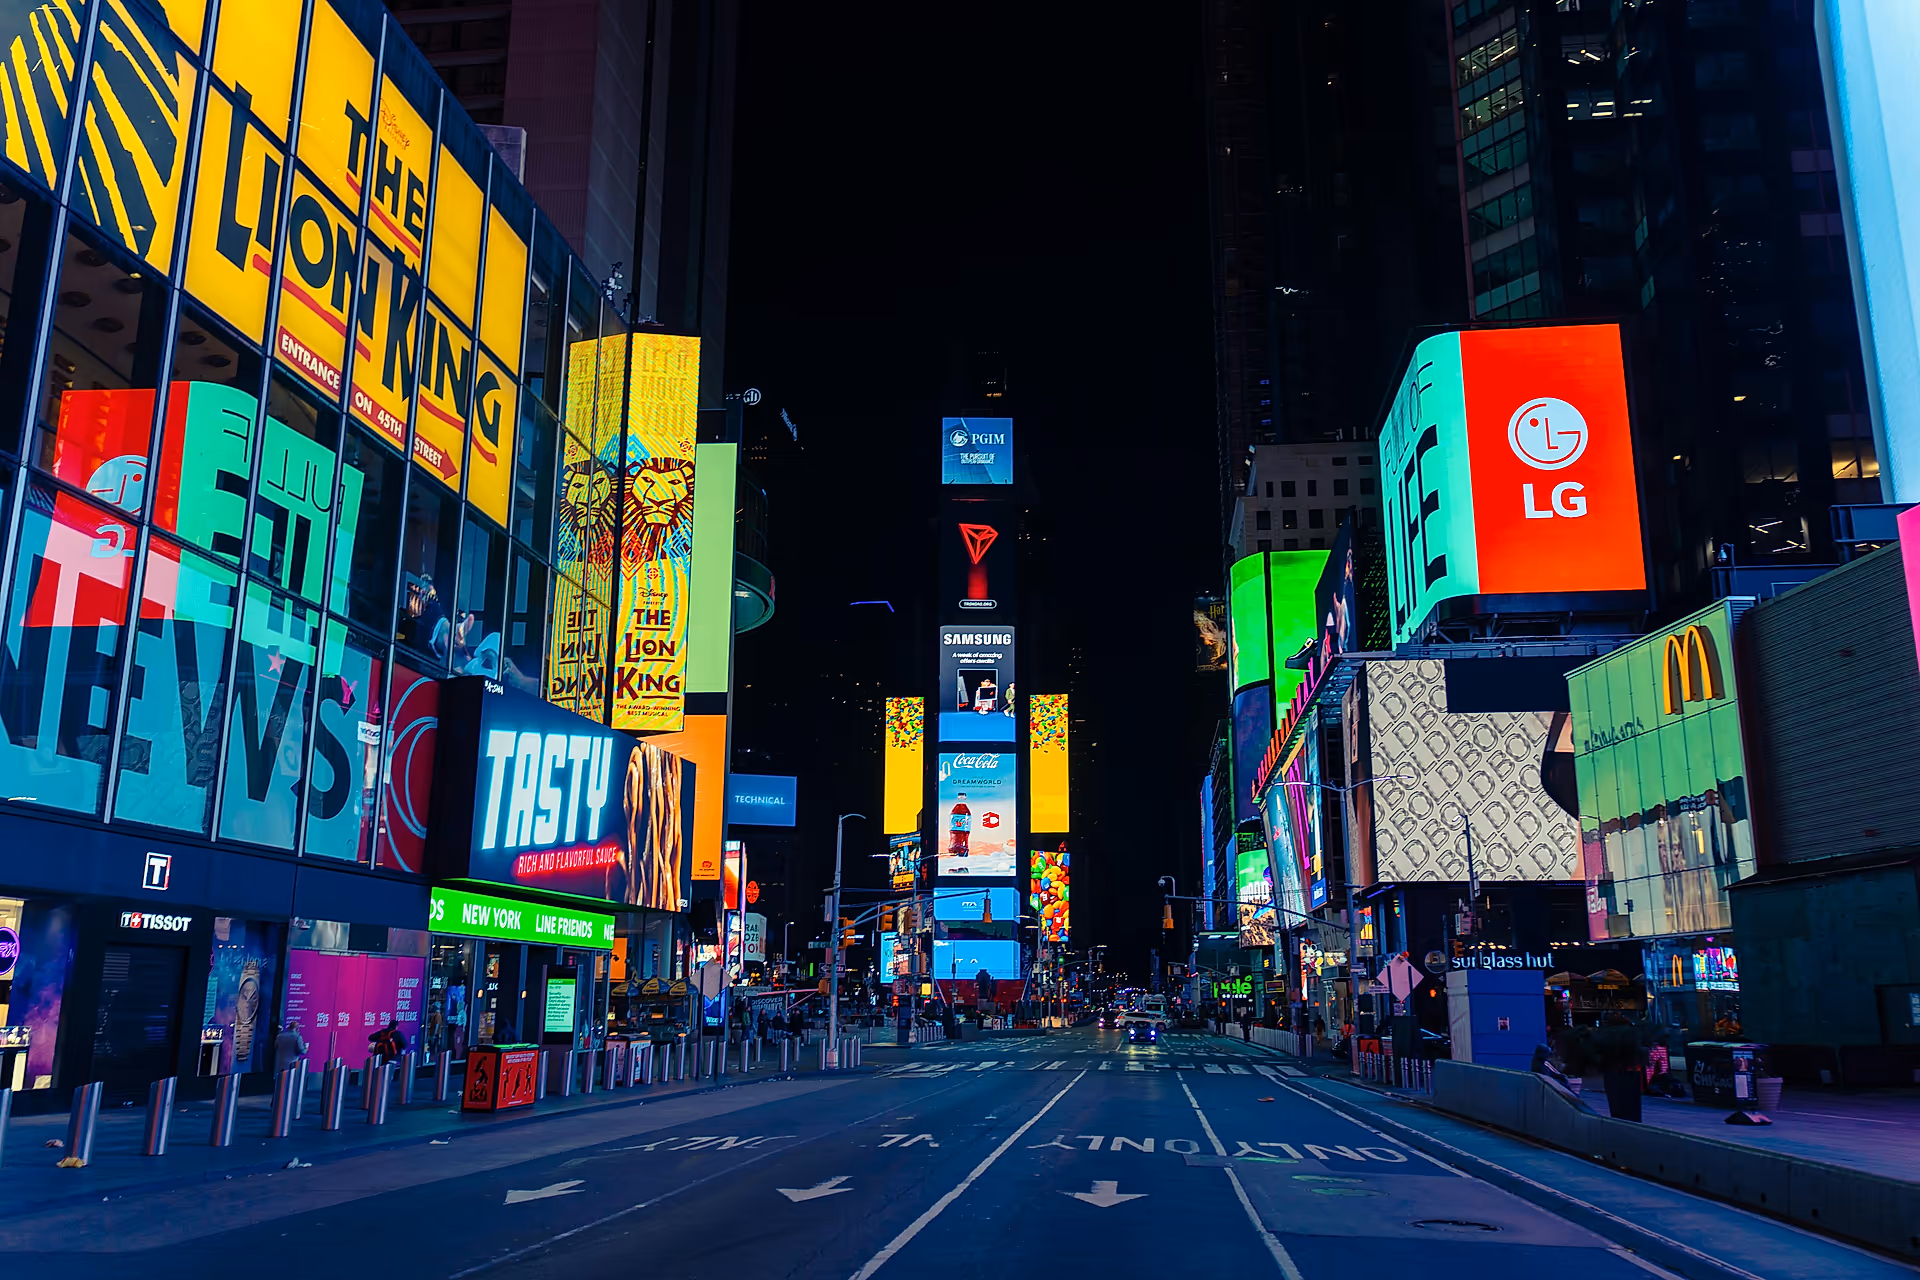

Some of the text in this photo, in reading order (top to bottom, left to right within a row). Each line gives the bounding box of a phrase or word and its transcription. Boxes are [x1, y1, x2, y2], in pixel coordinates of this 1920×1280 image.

[345, 98, 425, 243] THE
[216, 80, 500, 448] LION KING
[280, 333, 444, 469] ENTRANCE ON 45TH STREET
[971, 433, 1006, 445] PGIM
[1522, 481, 1588, 520] LG
[634, 609, 671, 626] THE
[625, 632, 676, 663] LION
[943, 633, 1012, 646] SAMSUNG
[616, 666, 681, 700] KING
[482, 729, 614, 850] TASTY
[734, 795, 786, 805] TECHNICAL
[517, 846, 618, 874] RICH AND FLAVORFUL SAUCE
[142, 914, 192, 931] TISSOT
[462, 903, 492, 927] NEW
[493, 908, 522, 930] YORK
[535, 914, 556, 934] LINE
[557, 917, 593, 939] FRIENDS
[1451, 951, 1555, 971] sunglass hut
[1027, 1134, 1200, 1156] ONLY
[1231, 1141, 1409, 1163] ONLY
